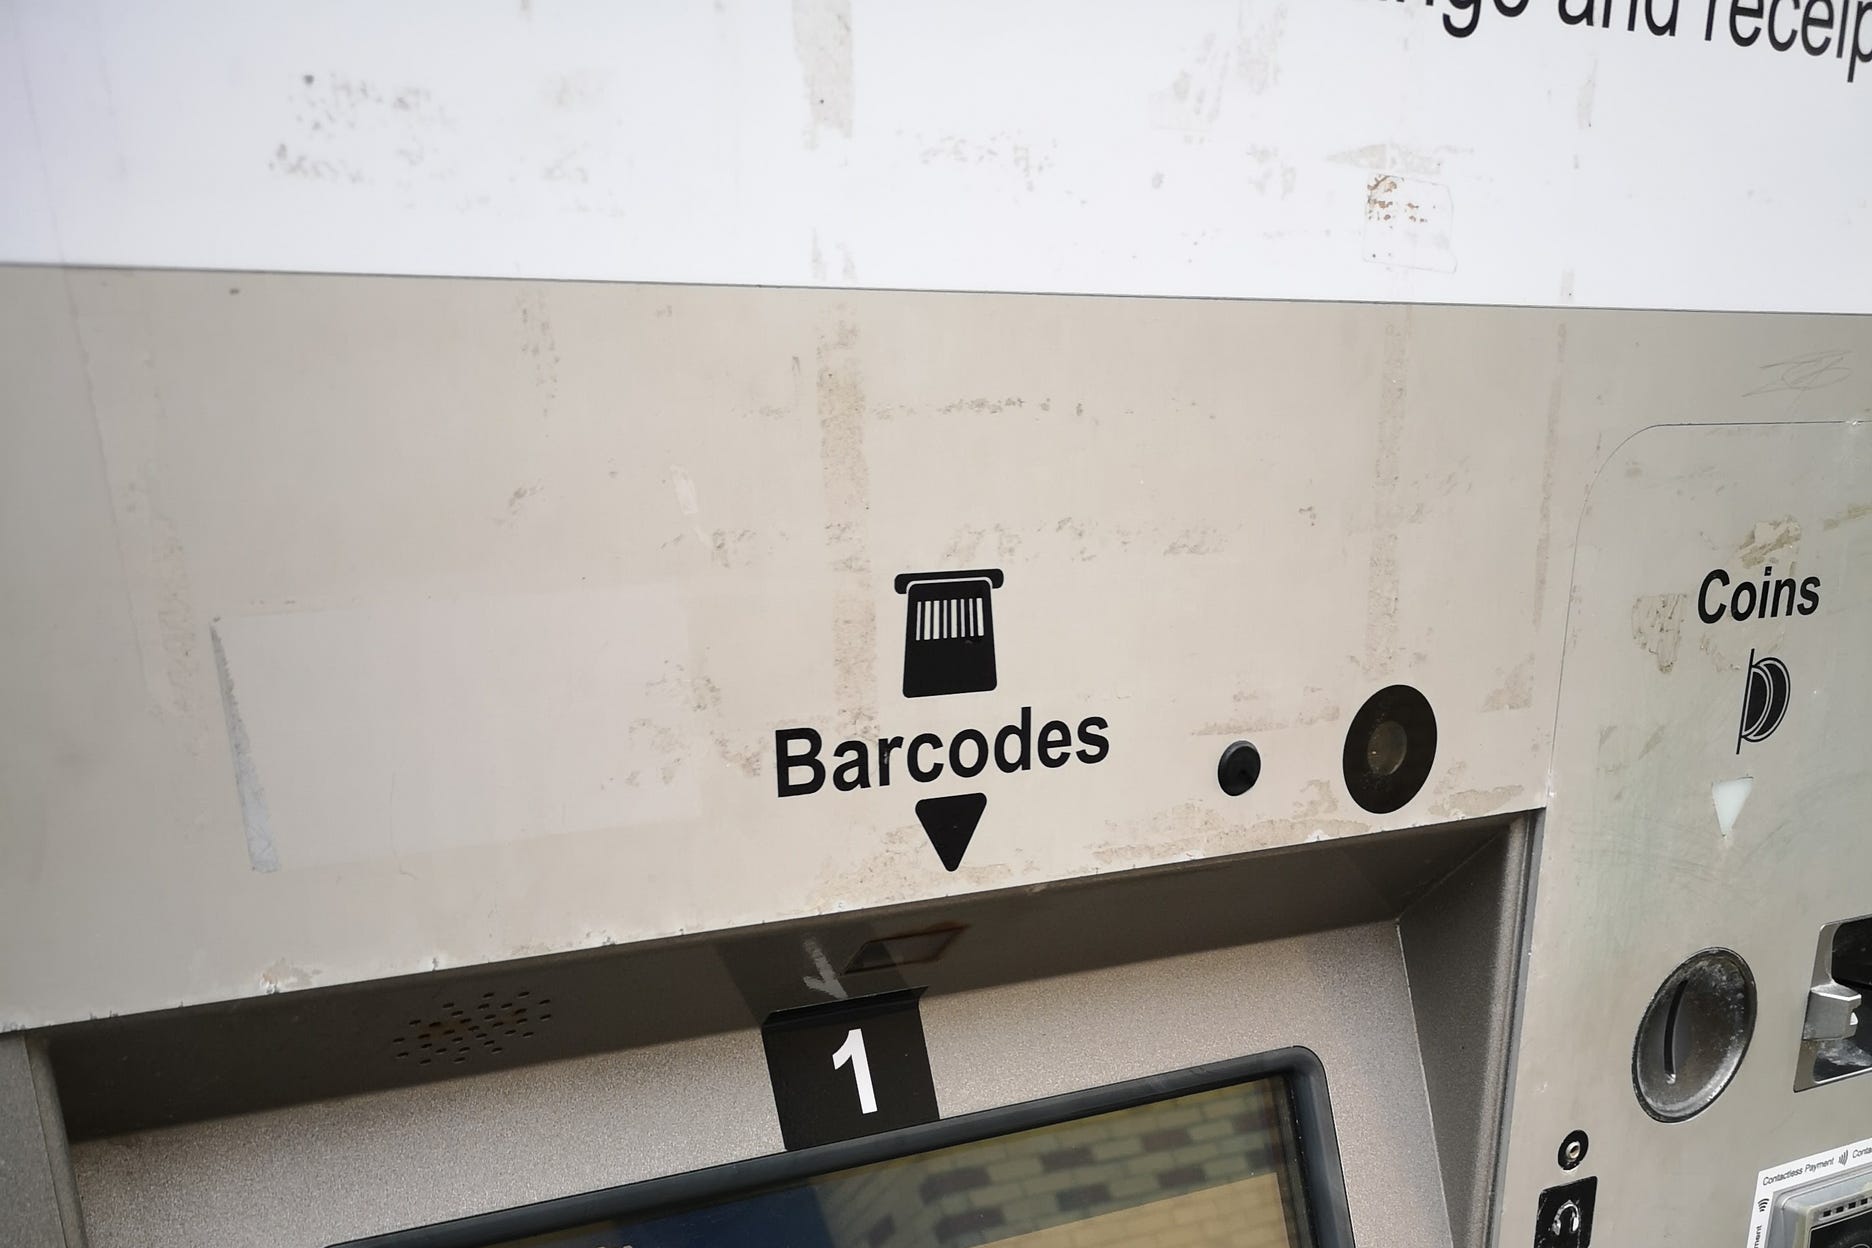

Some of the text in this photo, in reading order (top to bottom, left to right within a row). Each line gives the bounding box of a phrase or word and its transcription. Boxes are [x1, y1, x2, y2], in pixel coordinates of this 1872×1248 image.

[1697, 566, 1821, 624] Coins
[775, 706, 1110, 798] Barcodes
[832, 1028, 878, 1114] 1
[1762, 1157, 1835, 1186] Contactless Payment
